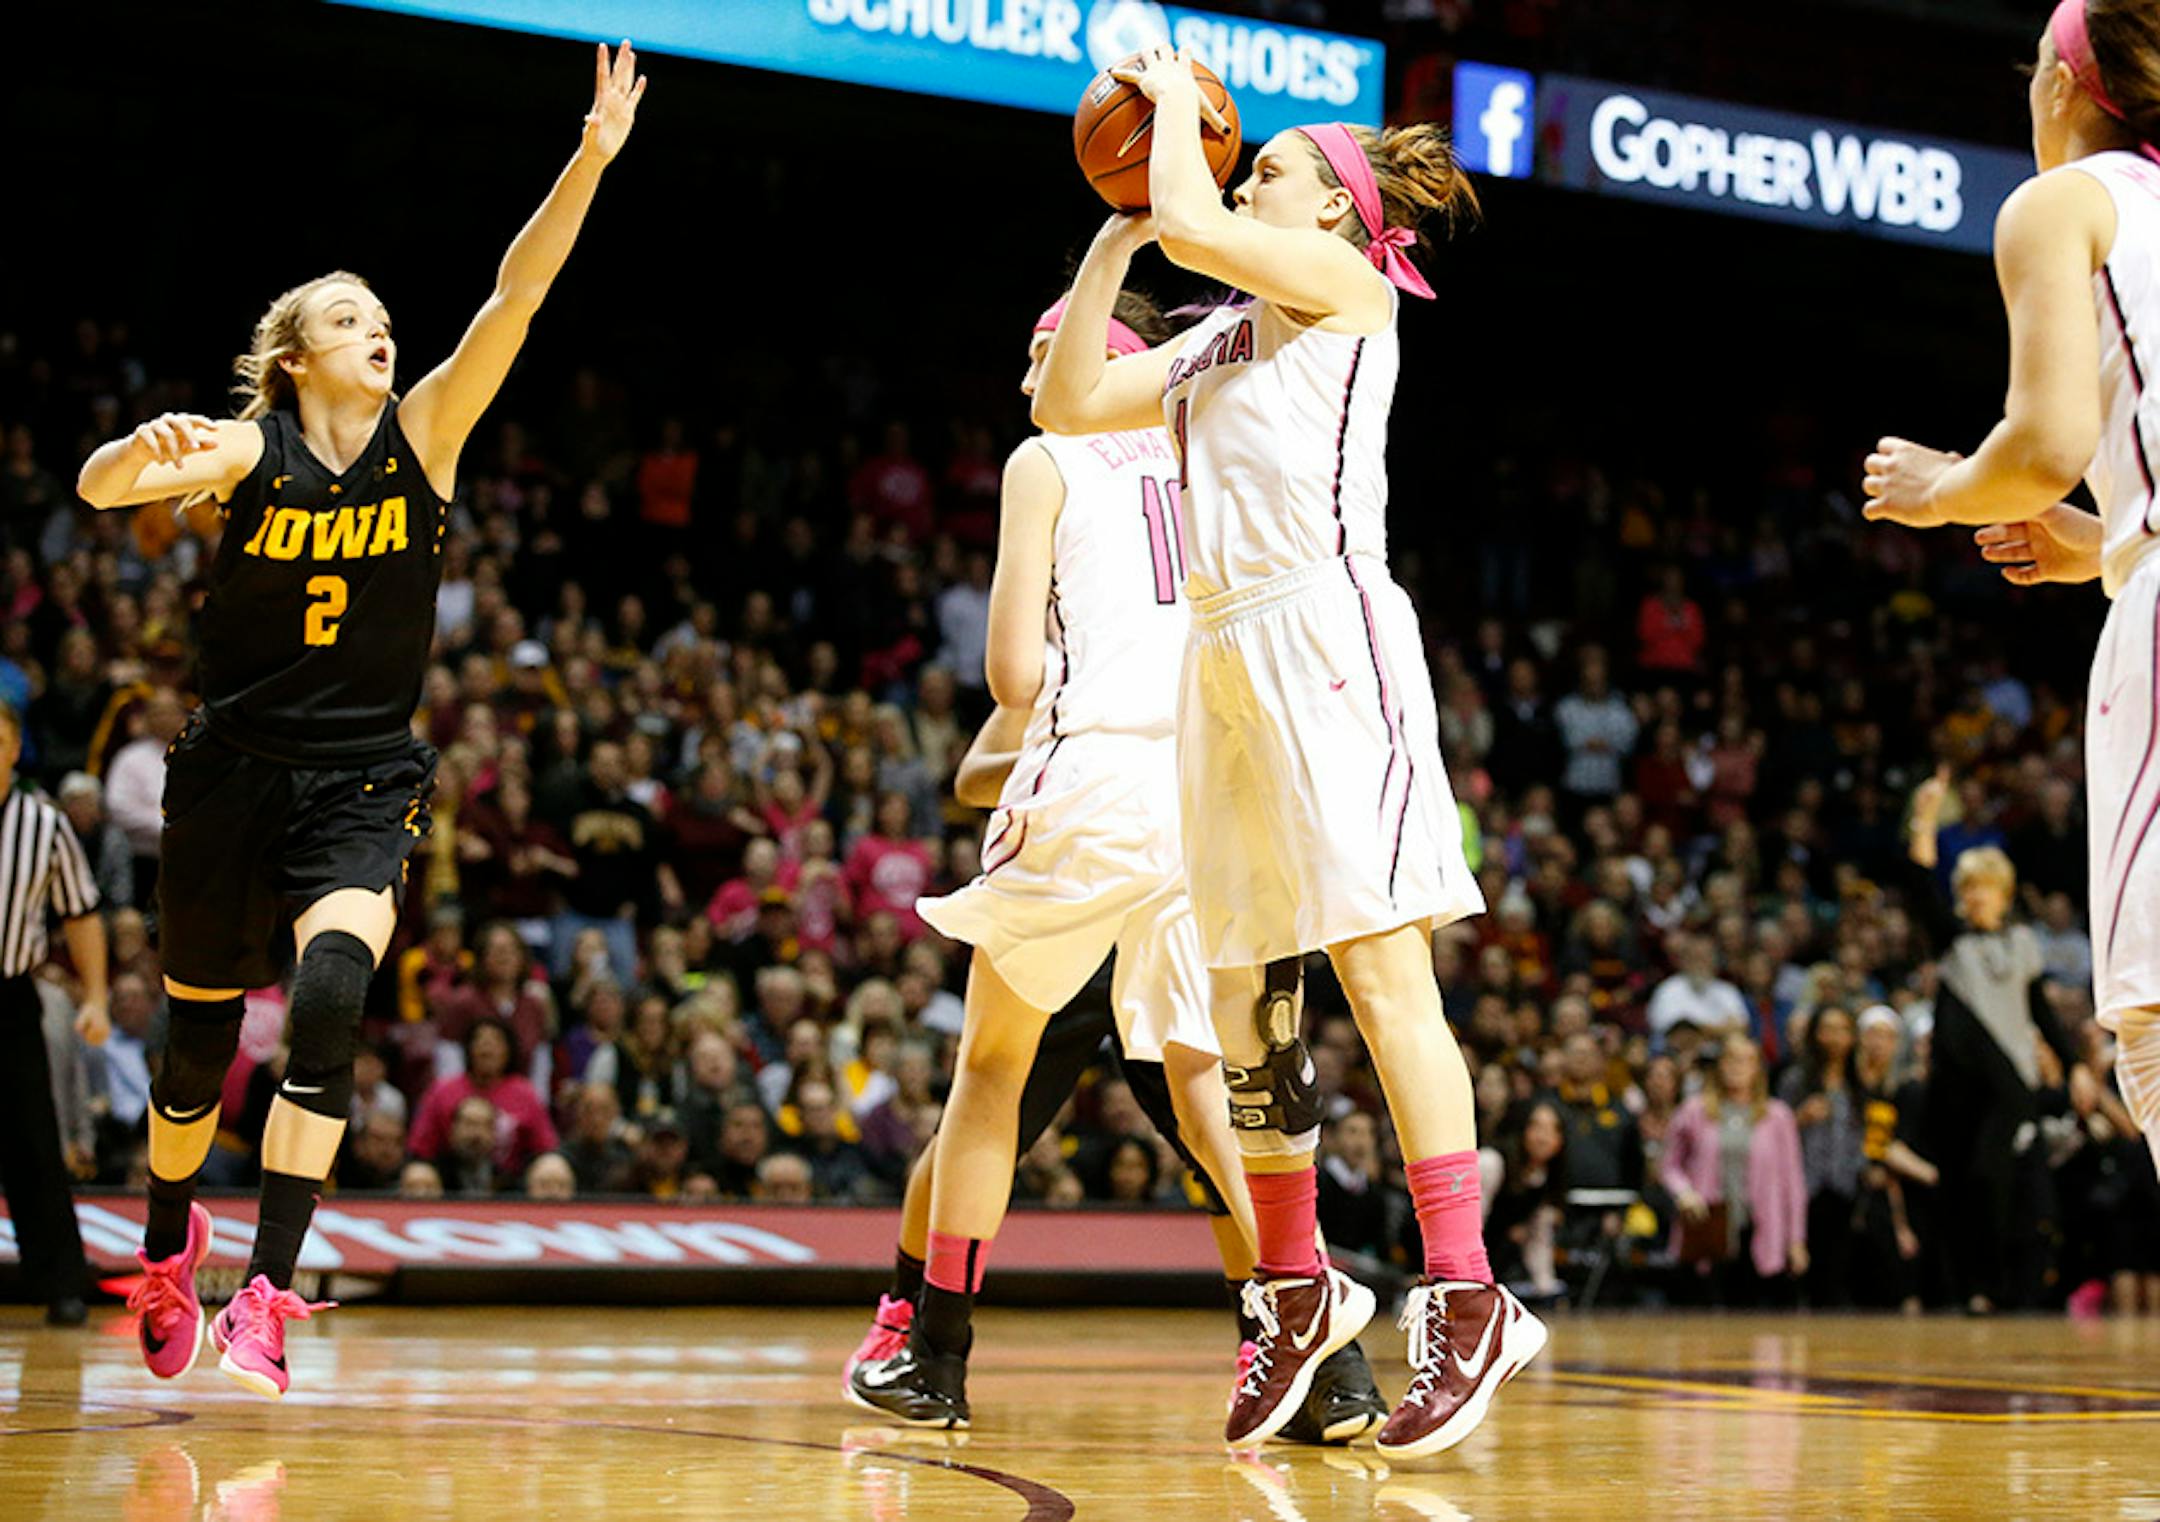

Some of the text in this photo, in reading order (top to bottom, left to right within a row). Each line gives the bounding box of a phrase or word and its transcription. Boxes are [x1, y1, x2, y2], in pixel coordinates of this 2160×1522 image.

[1174, 16, 1359, 106] SHOES
[1087, 430, 1171, 470] EDWA
[243, 496, 409, 561] IOWA
[303, 574, 348, 647] 2
